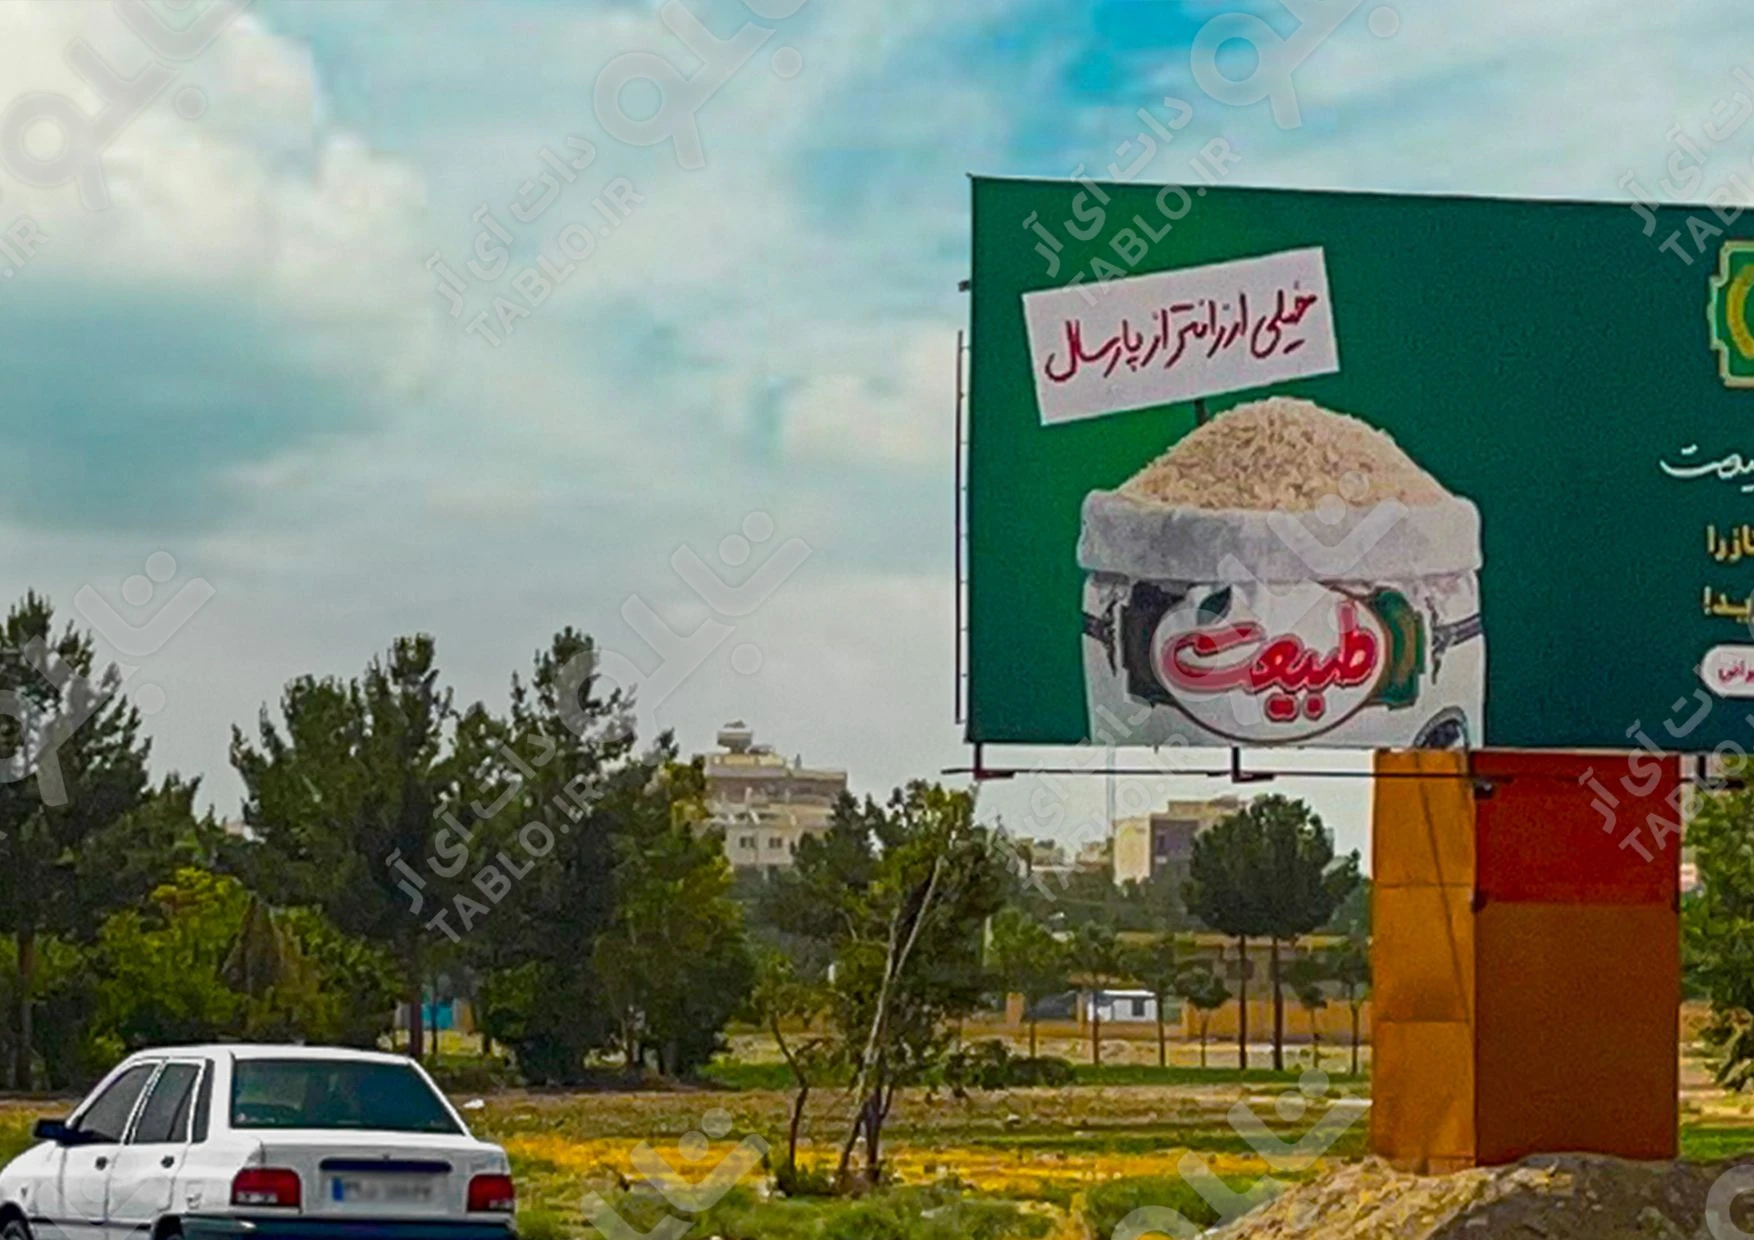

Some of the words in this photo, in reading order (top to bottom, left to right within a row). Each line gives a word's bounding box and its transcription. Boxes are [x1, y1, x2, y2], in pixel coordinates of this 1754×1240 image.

[1250, 280, 1318, 360] خیلی
[1705, 524, 1728, 562] را
[1162, 599, 1378, 720] طبیعت
